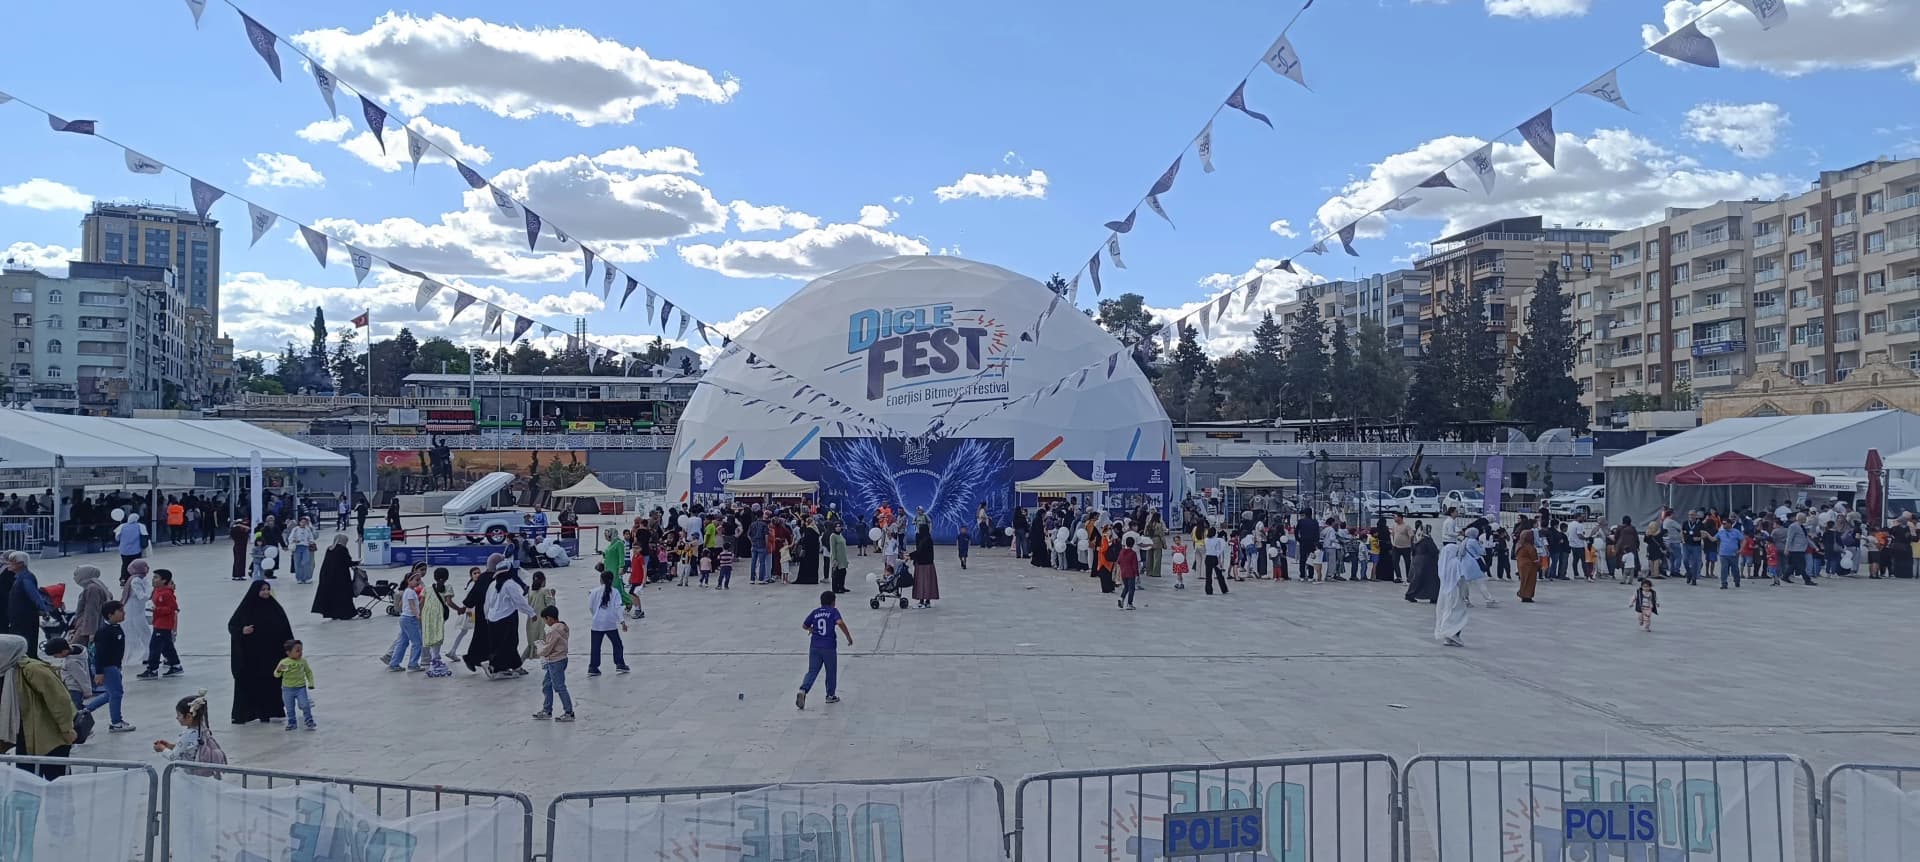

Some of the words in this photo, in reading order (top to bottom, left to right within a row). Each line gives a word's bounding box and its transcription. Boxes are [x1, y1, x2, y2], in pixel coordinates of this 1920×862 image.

[867, 327, 988, 401] FEST
[886, 390, 922, 406] Enerjisi
[925, 384, 971, 401] Bitmeyn
[973, 381, 1010, 395] Festival
[817, 618, 827, 636] 9
